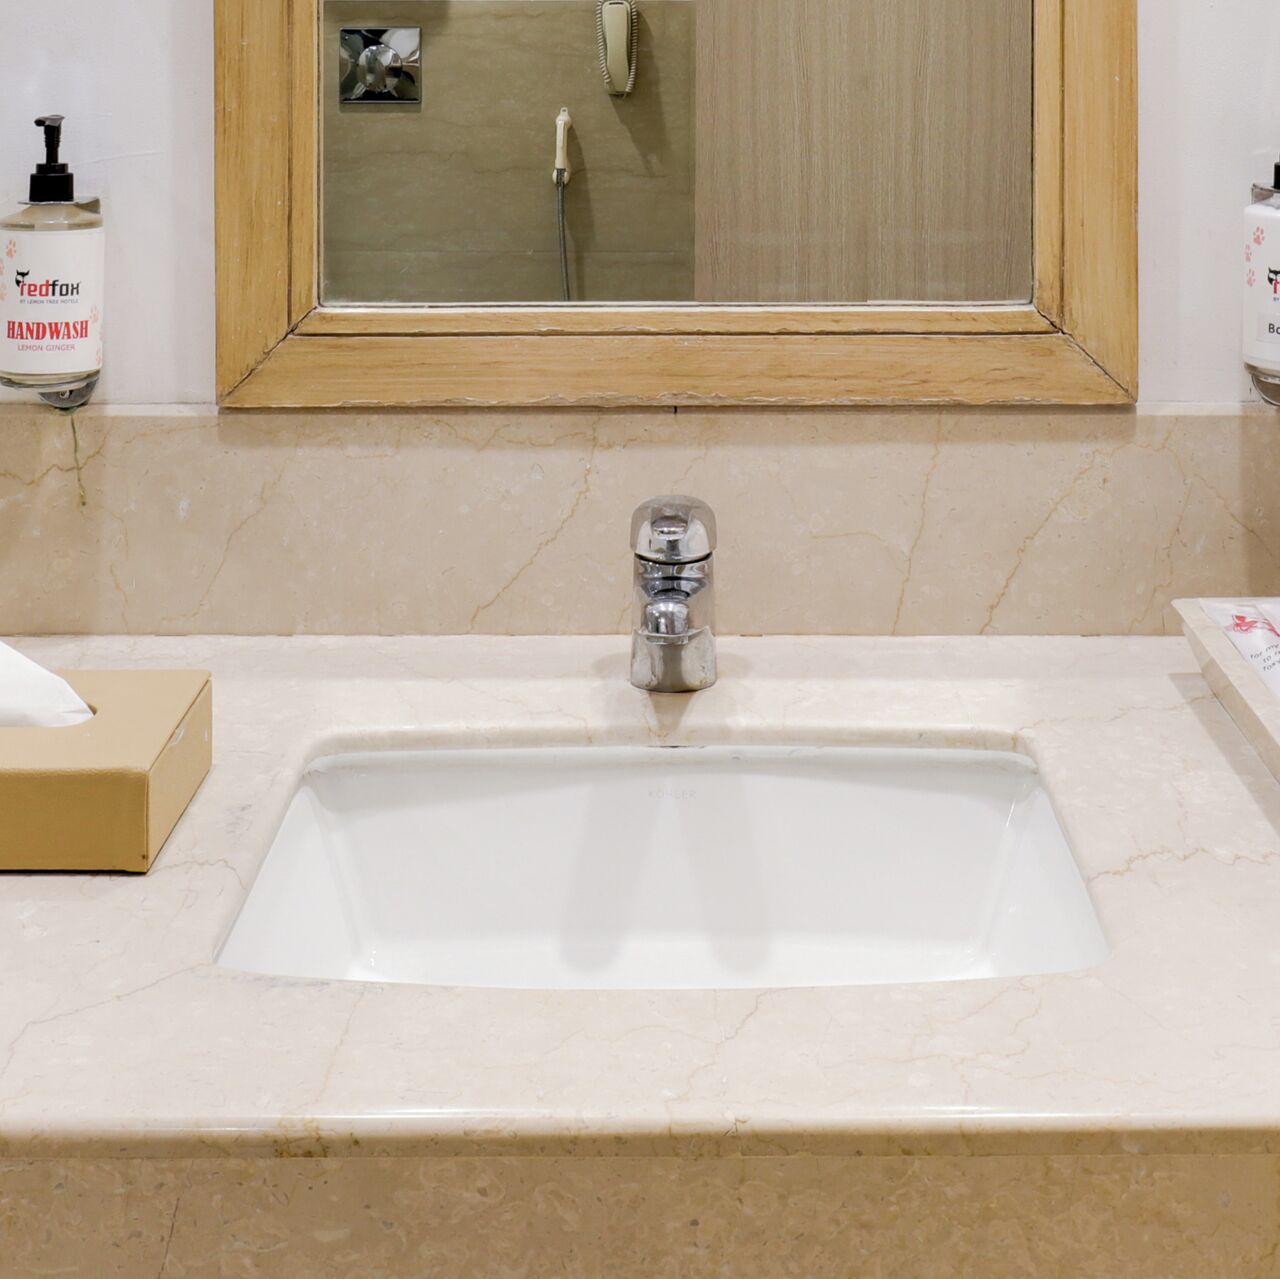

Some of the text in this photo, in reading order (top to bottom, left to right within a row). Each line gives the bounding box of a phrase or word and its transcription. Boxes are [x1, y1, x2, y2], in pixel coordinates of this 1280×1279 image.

[20, 279, 80, 297] redfox
[7, 320, 89, 341] HANDWASH
[17, 344, 76, 352] LEMON GINGER
[1250, 651, 1263, 660] for
[1265, 643, 1280, 652] my
[1262, 655, 1272, 664] to
